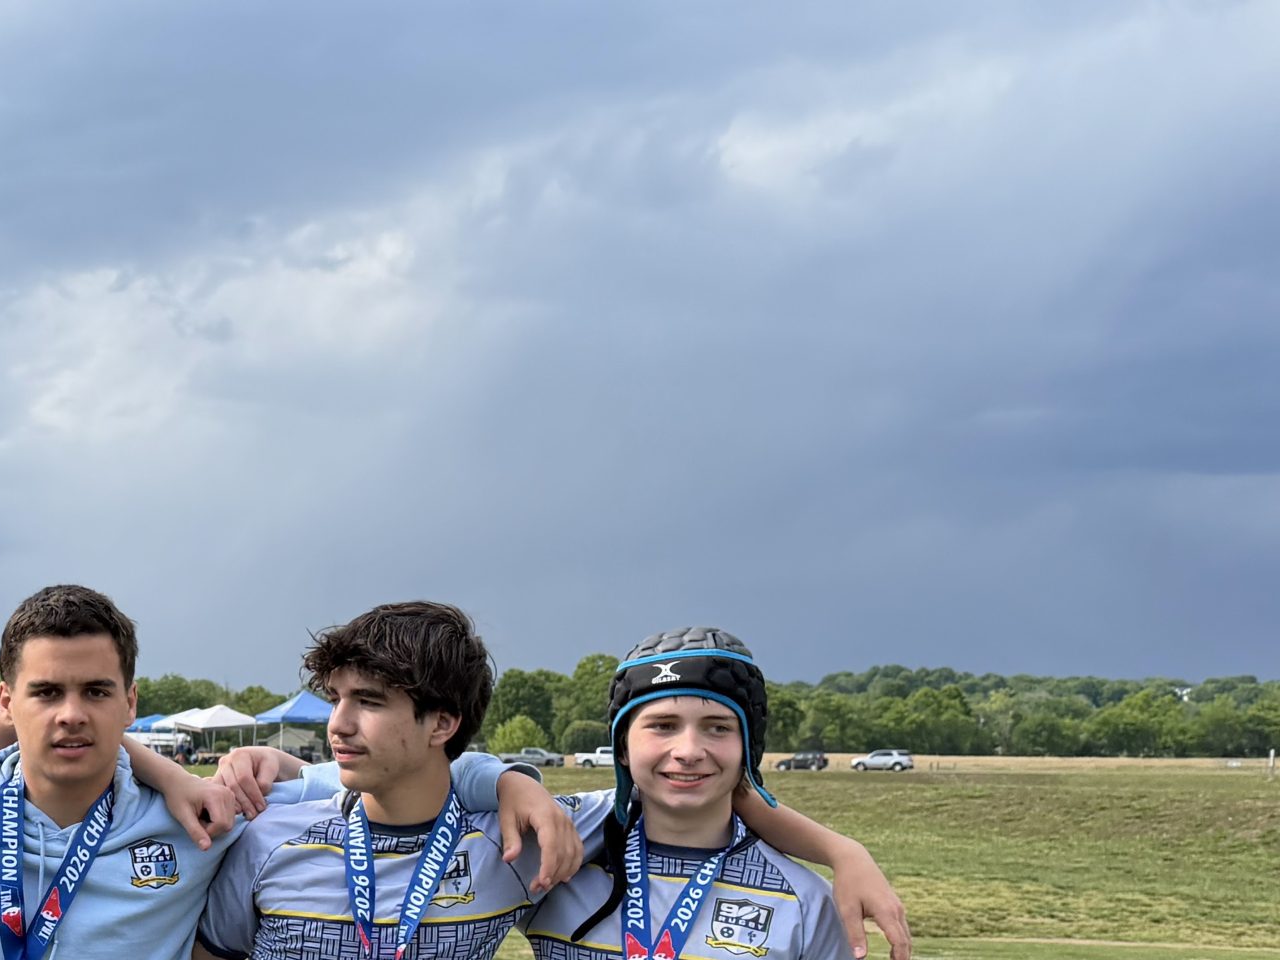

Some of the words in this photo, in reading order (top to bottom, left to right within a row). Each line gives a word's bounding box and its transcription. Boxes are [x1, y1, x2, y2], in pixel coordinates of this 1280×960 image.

[1, 787, 19, 882] CHAMPION
[134, 843, 170, 857] 901
[59, 845, 91, 893] 2026
[135, 855, 171, 863] RUGBY
[405, 825, 453, 920] CHAMPION
[0, 889, 10, 910] TRA
[352, 875, 370, 922] 2026
[626, 886, 645, 930] 2026
[670, 887, 703, 933] 2026
[719, 902, 769, 924] 901
[38, 921, 57, 940] TRA
[718, 915, 764, 930] RUGBY
